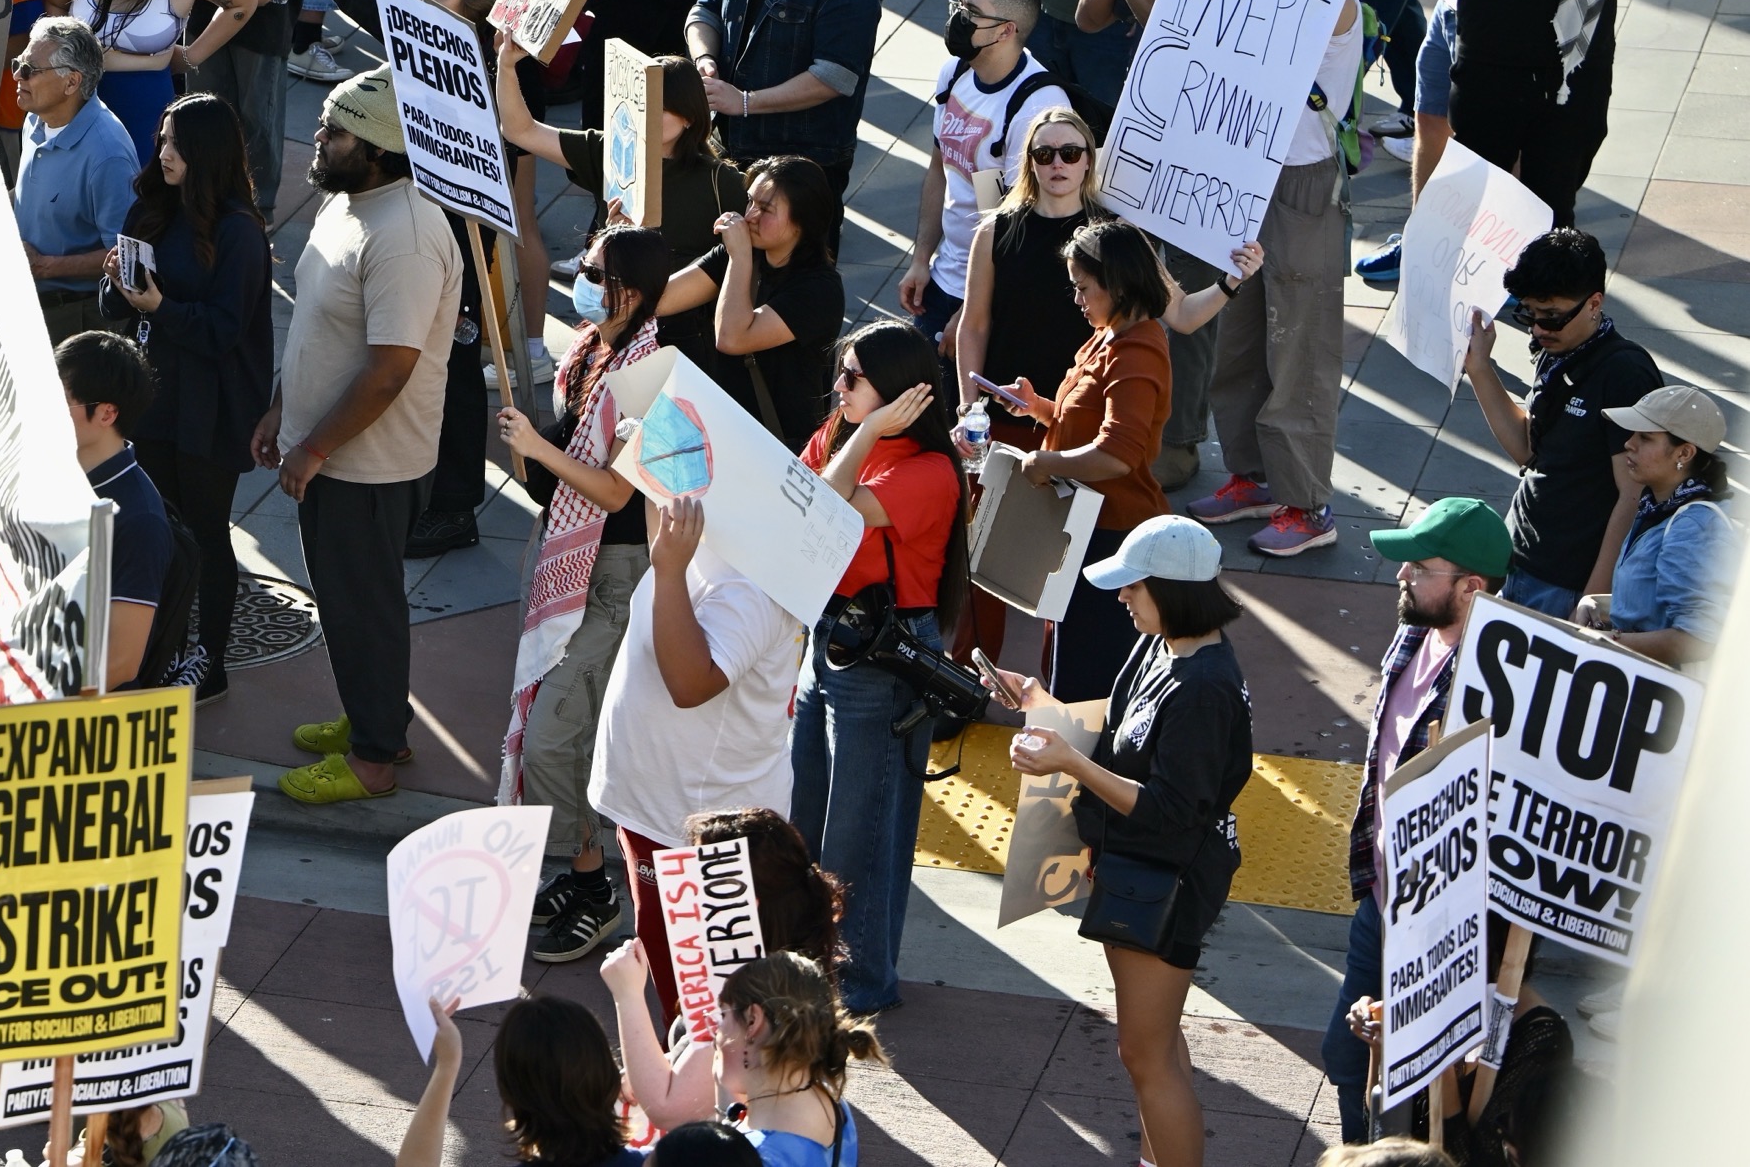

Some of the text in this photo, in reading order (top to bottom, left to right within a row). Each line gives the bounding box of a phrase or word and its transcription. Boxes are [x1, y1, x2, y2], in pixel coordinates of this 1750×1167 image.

[386, 4, 477, 68] ¡DERECHOS
[391, 34, 487, 111] PLENOS
[1130, 35, 1283, 166] CRIMINAL
[403, 101, 498, 161] PARA TODOS LOS
[407, 123, 502, 186] INMIGRANTES!
[1100, 116, 1267, 243] ENTERPRISE
[898, 642, 917, 659] PYLE
[126, 704, 179, 765] THE
[1462, 617, 1687, 795] STOP
[1508, 778, 1652, 885] TERROR
[665, 881, 702, 925] IS
[60, 961, 168, 1000] OUT!
[8, 1020, 31, 1043] FOR
[31, 1014, 94, 1040] SOCIALISM
[94, 1014, 107, 1035] &
[107, 1002, 162, 1030] LIBERATION
